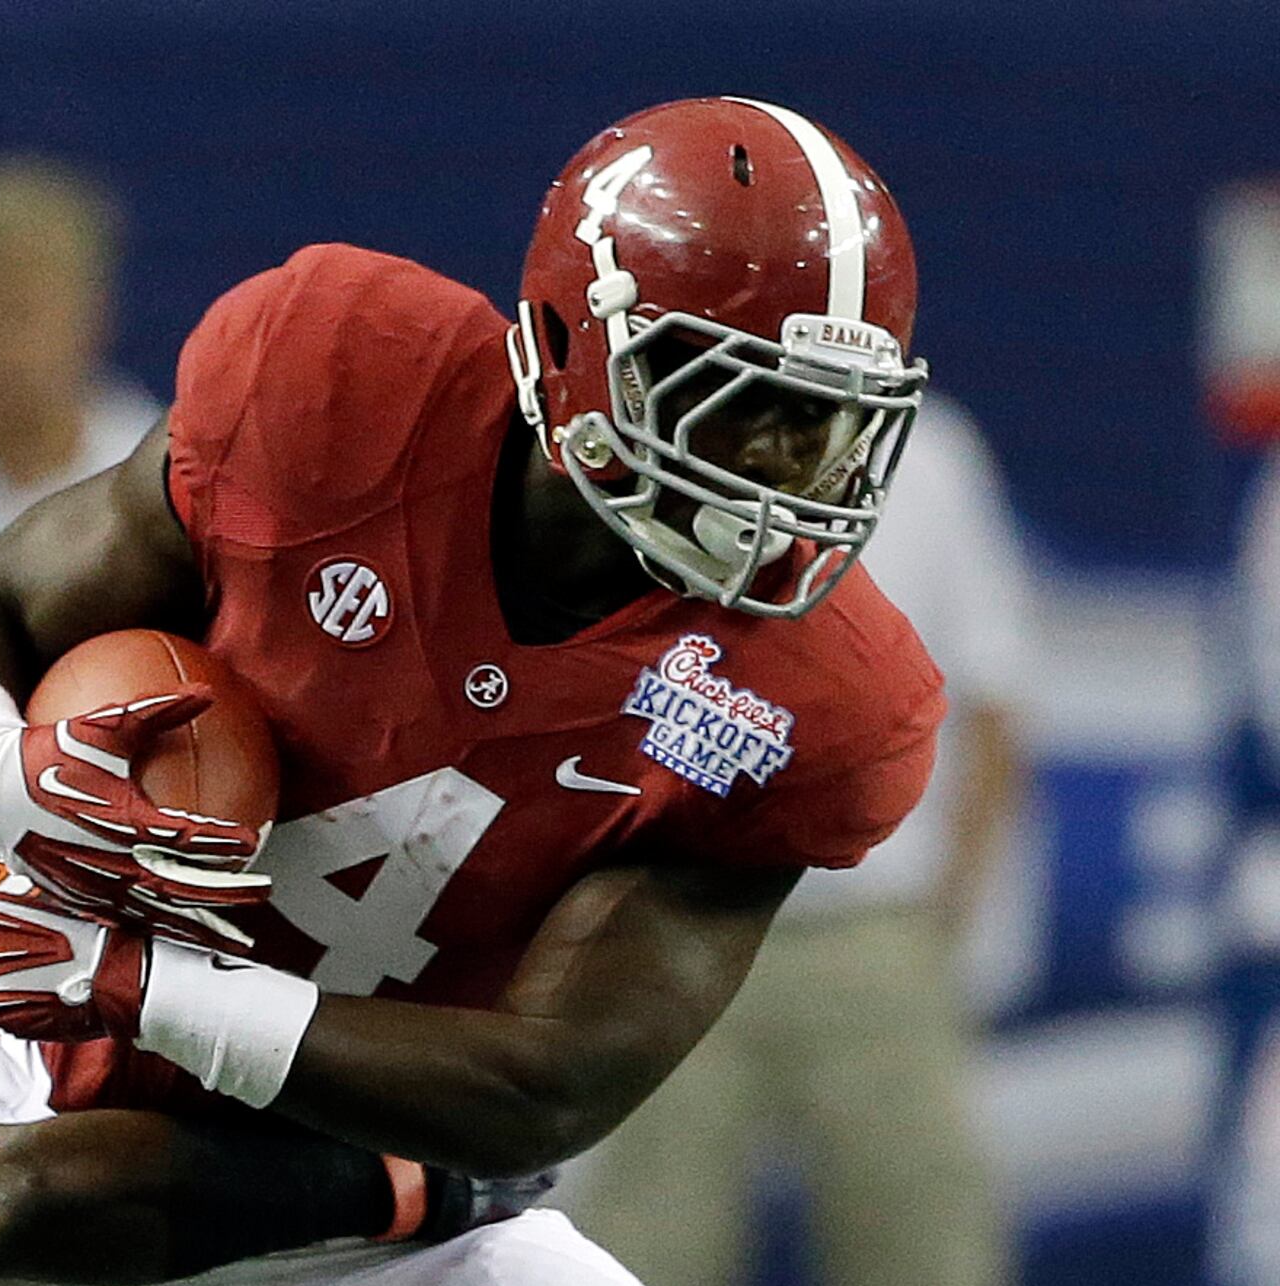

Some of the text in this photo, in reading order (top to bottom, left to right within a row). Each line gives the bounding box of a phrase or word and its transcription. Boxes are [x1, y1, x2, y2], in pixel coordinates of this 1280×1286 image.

[574, 145, 654, 246] 4
[822, 323, 873, 350] BAMA
[307, 562, 388, 642] SEC
[631, 677, 785, 776] KICKOFF
[653, 722, 736, 780] GAME
[642, 742, 728, 795] ATLANTA
[243, 766, 506, 998] 4
